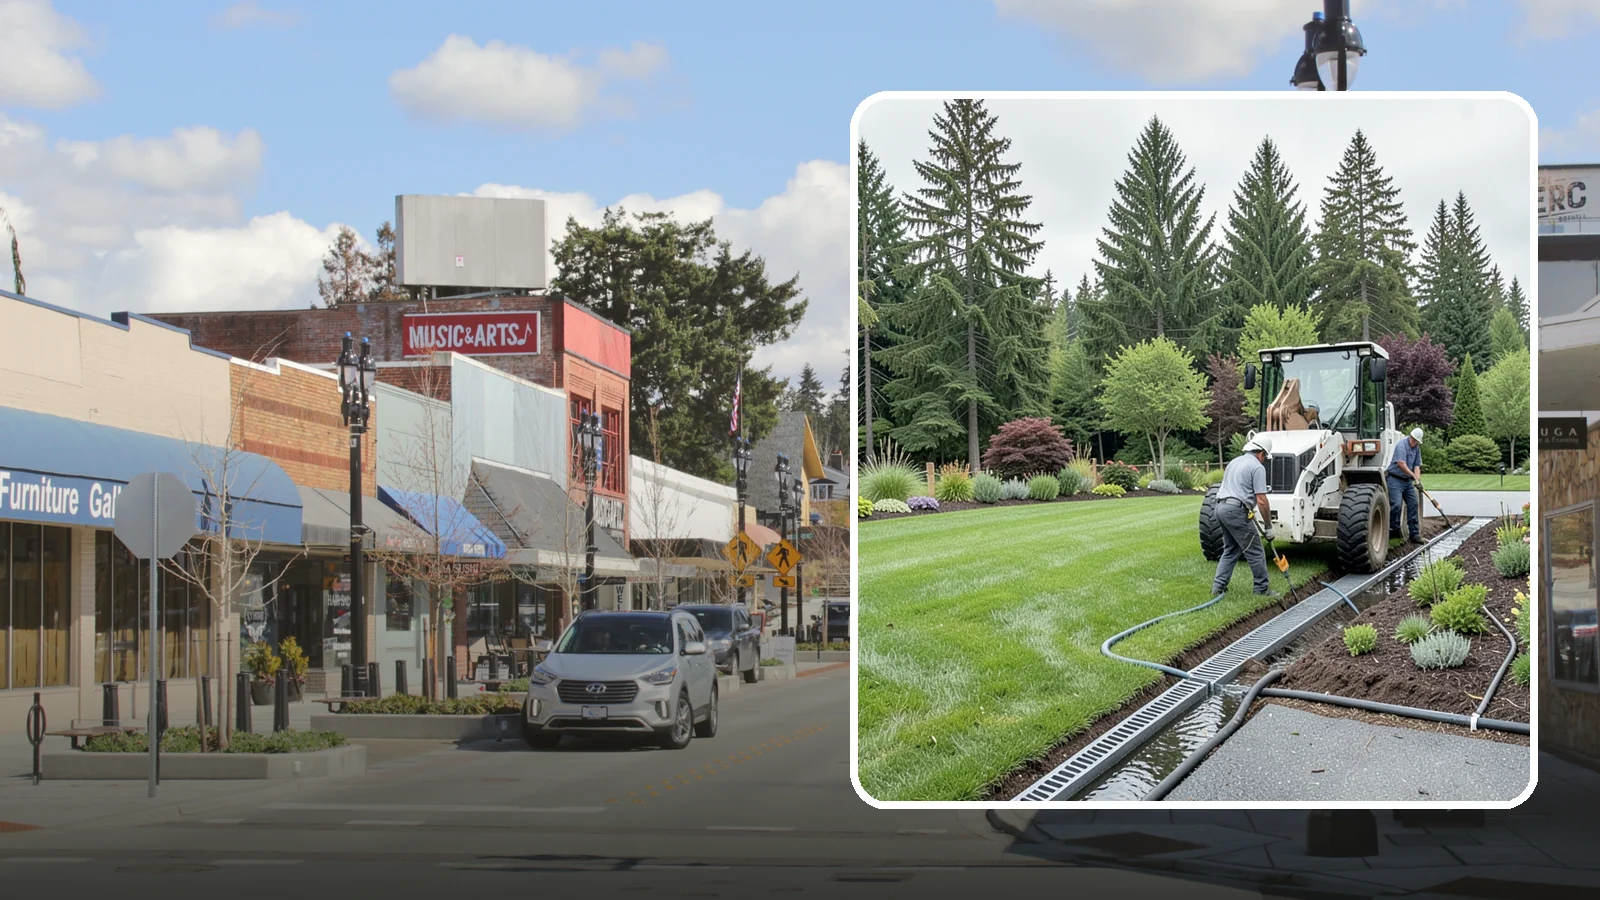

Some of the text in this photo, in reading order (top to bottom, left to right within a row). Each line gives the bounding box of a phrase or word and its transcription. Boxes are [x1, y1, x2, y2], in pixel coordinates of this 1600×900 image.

[0, 471, 122, 519] Furniture Gal
[453, 563, 479, 575] SUSHI
